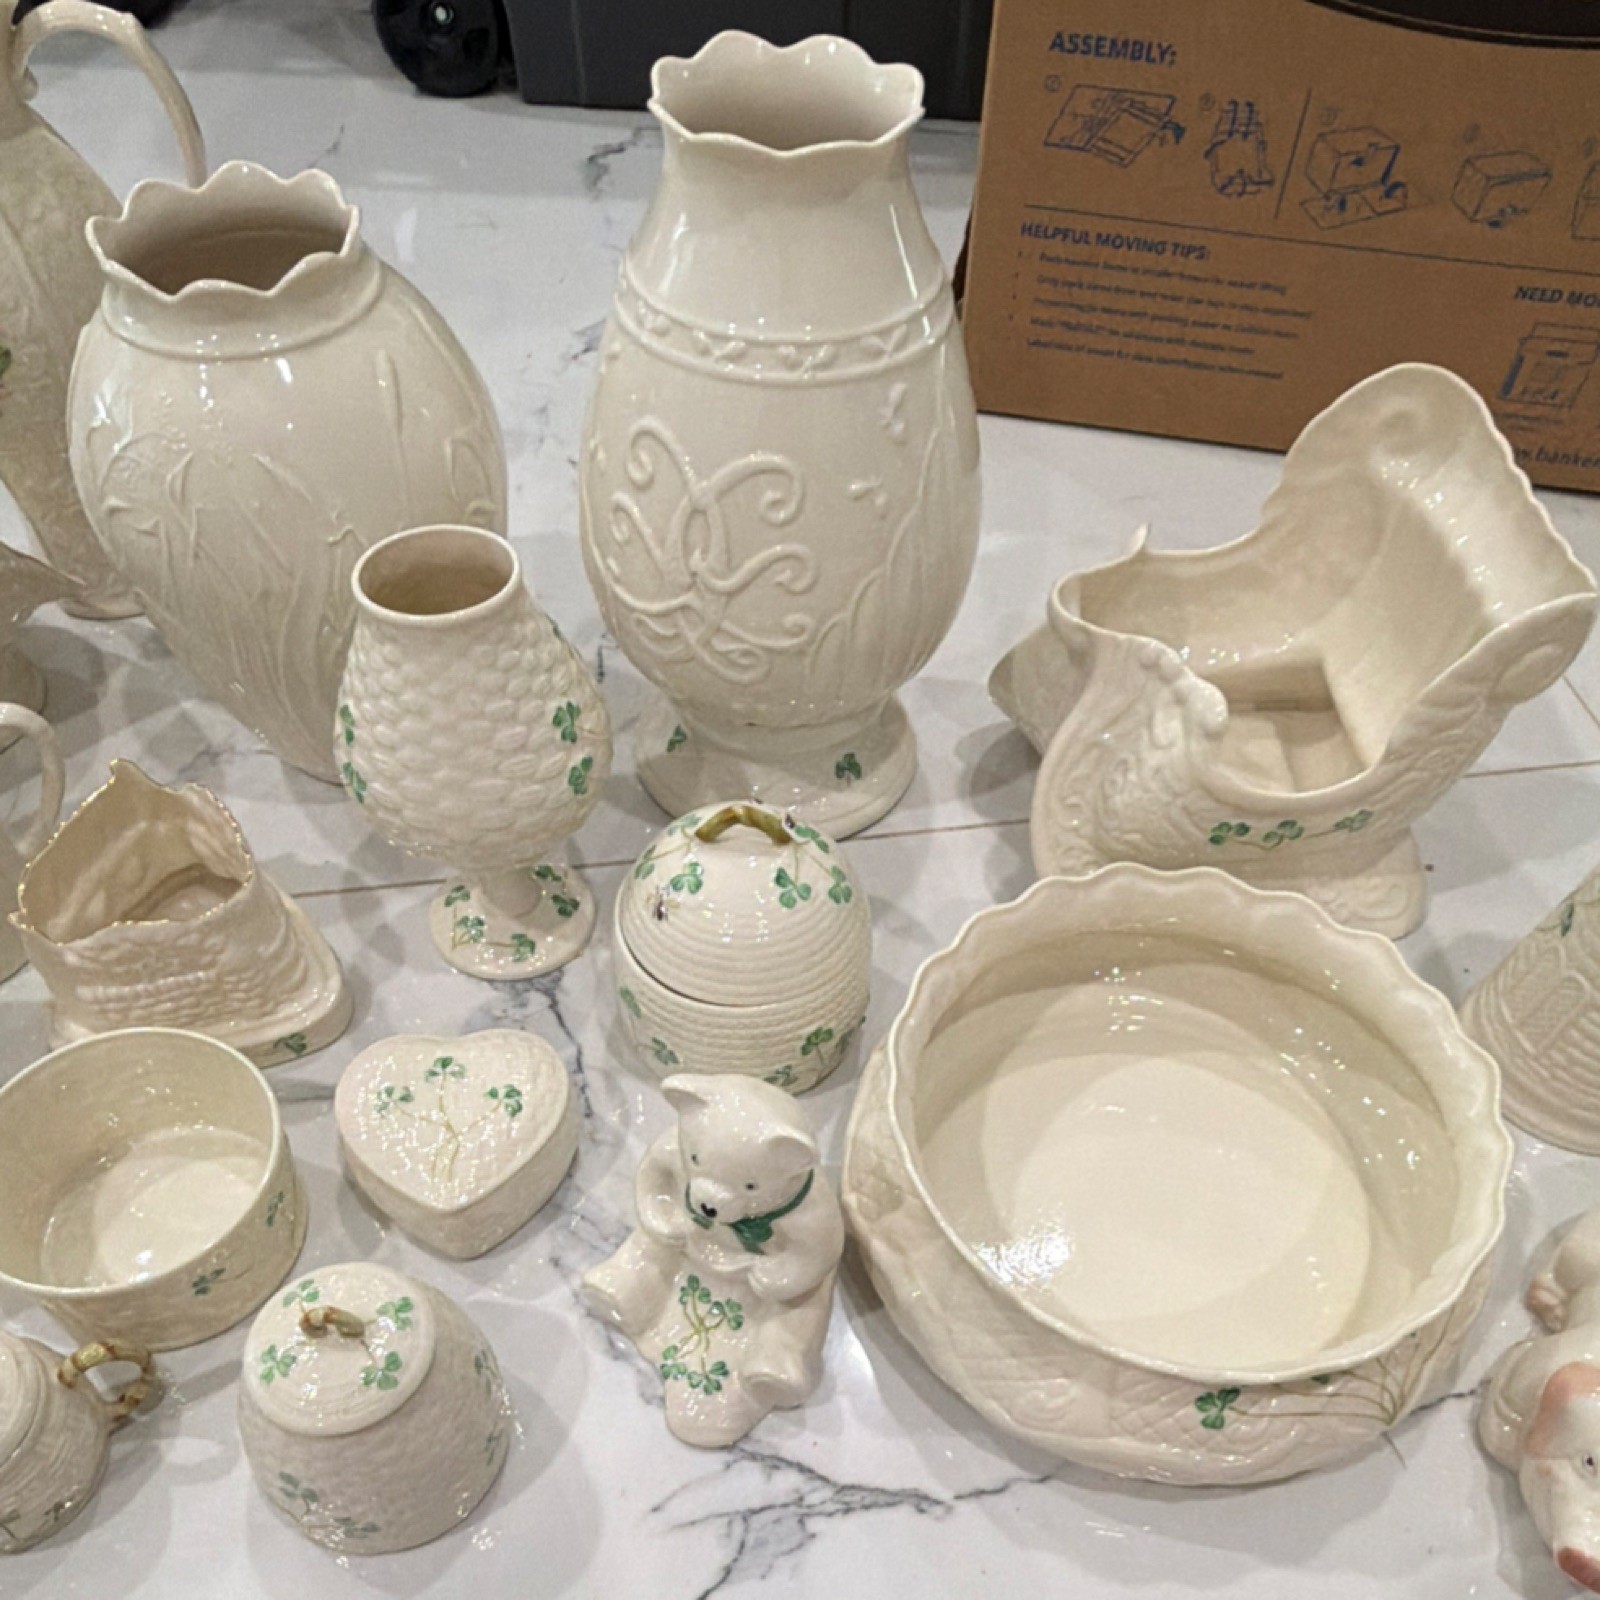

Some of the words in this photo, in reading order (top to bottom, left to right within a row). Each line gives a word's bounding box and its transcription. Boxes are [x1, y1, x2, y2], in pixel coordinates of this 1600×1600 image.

[1049, 32, 1177, 67] ASSEMBLY:
[1020, 221, 1091, 246] HELPFUL
[1095, 231, 1168, 256] MOVING
[1514, 286, 1563, 303] NEED
[1566, 290, 1600, 308] MO
